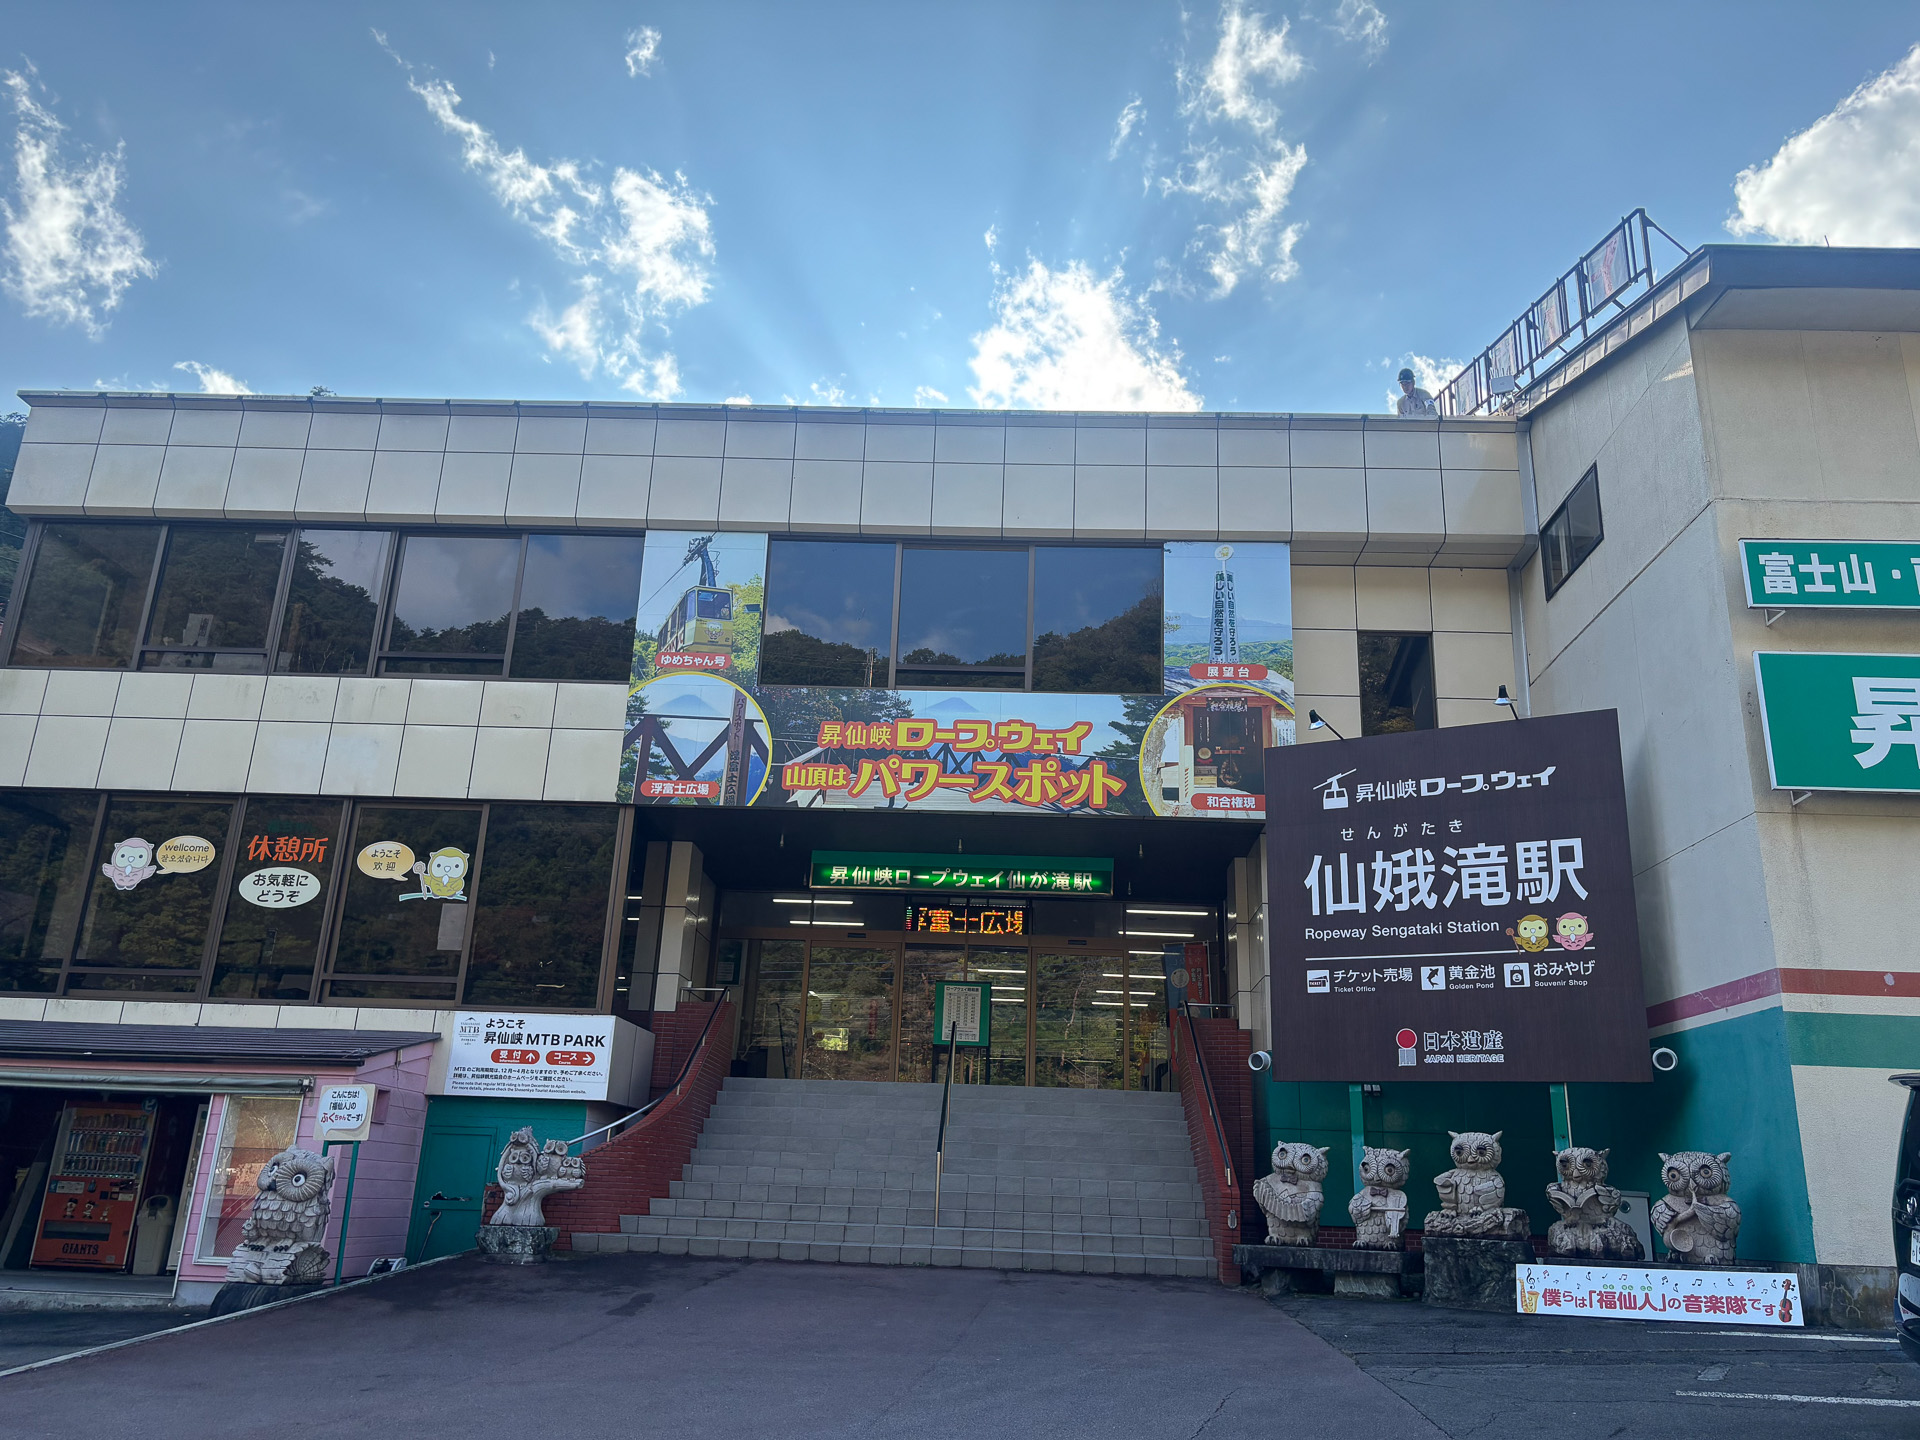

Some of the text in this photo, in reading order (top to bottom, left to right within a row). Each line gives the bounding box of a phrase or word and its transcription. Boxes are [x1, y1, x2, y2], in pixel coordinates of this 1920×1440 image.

[1758, 552, 1920, 595] 富士山・
[660, 654, 726, 667] ゆめちゃん号
[1207, 666, 1250, 679] 展望台
[650, 783, 710, 795] 浮富士広場
[785, 757, 1123, 806] 山頂はパワースポット
[1355, 765, 1557, 803] 昇仙峡ロープウェイ
[1206, 796, 1256, 809] 和合権現
[1340, 819, 1463, 842] せんがたき
[164, 843, 210, 853] wellcome
[247, 835, 328, 863] 休憩所
[370, 848, 401, 859] ようこそ
[252, 874, 309, 888] お気軽に
[829, 866, 1093, 892] 昇仙峡ロープウェイ仙が滝駅
[1304, 837, 1589, 916] 仙娥滝駅
[256, 889, 301, 904] どうぞ
[1305, 919, 1500, 942] Ropeway Sengataki Station
[1333, 967, 1413, 983] チケット売場
[1448, 964, 1496, 981] 黄金池
[1533, 959, 1596, 977] おみやげ
[1568, 979, 1588, 987] Shop
[459, 1026, 480, 1034] MTB
[485, 1018, 526, 1029] ようこそ
[483, 1031, 606, 1048] 昇仙峡 MTB PARK
[1423, 1030, 1504, 1051] 日本遺産
[499, 1050, 522, 1059] 受付
[553, 1052, 578, 1061] コース
[1424, 1053, 1504, 1063] JAPAN HERITAGE
[62, 1243, 99, 1256] GIANTS
[1542, 1287, 1777, 1316] 僕らは「福仙人」の音楽隊です
